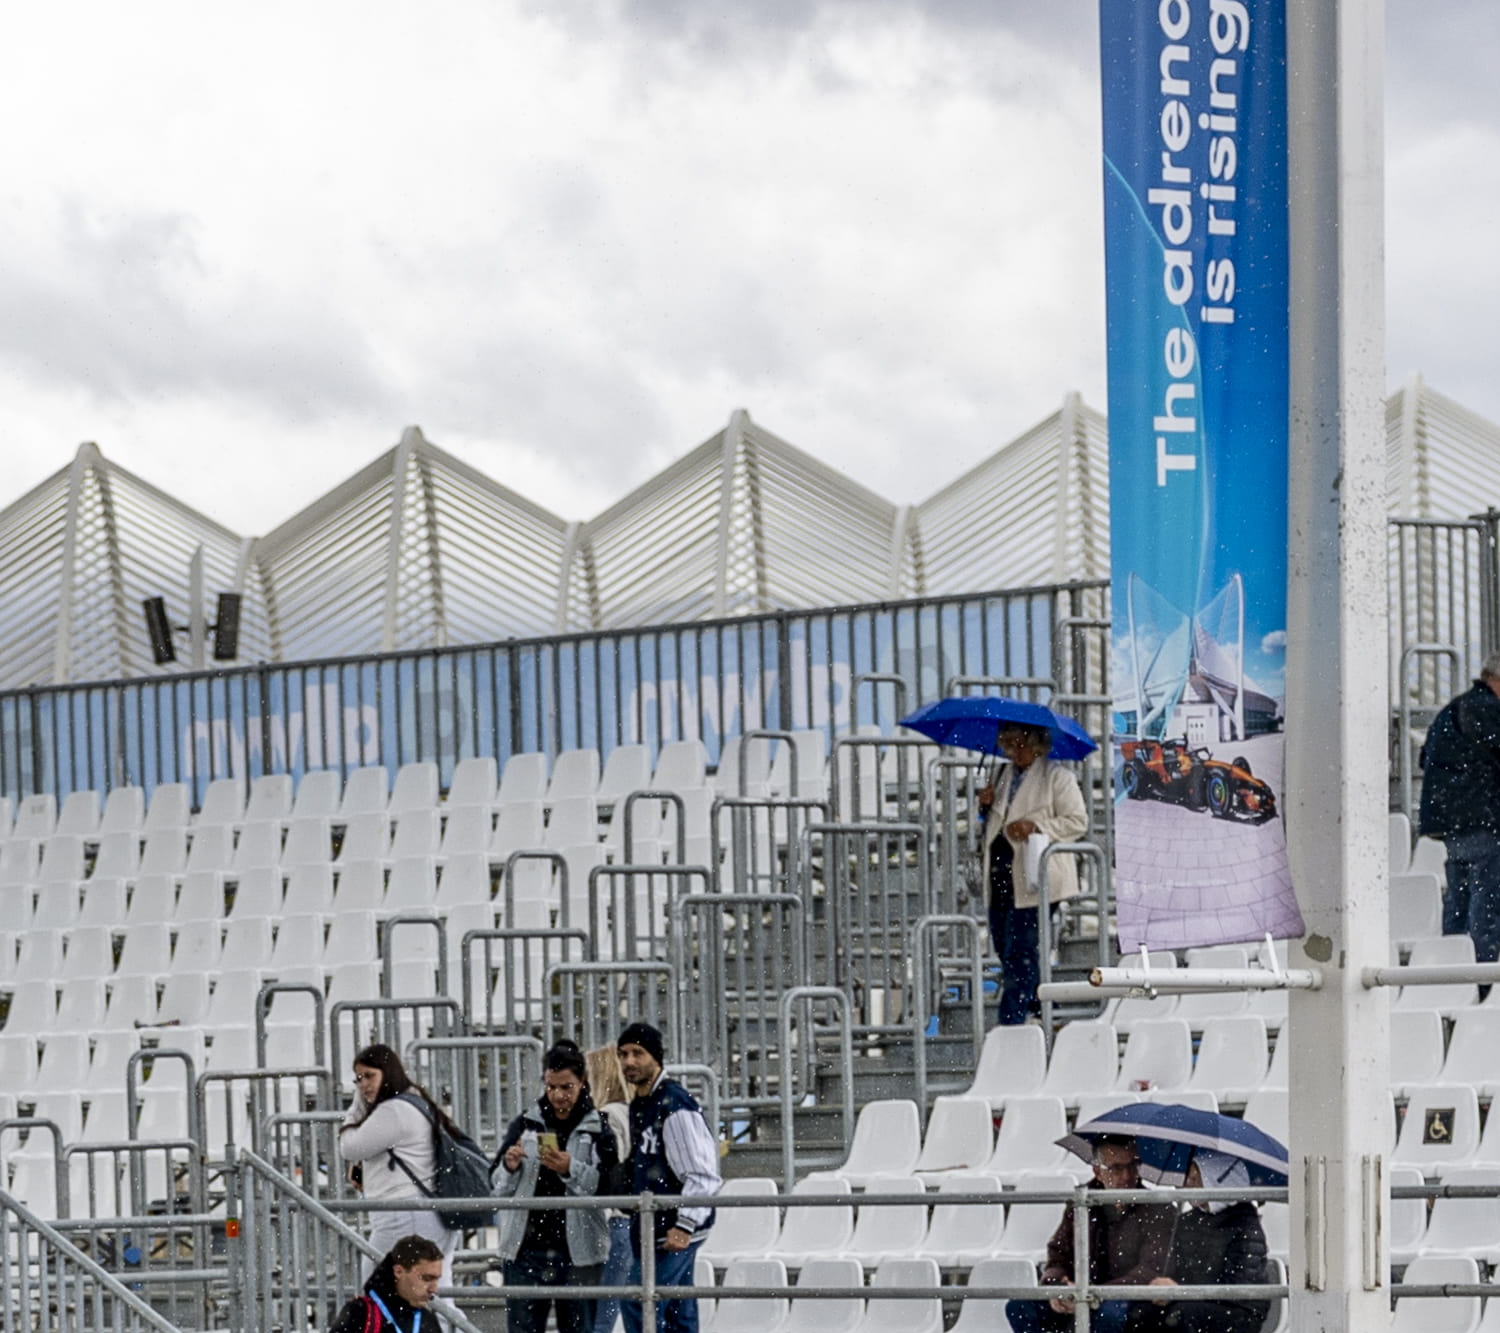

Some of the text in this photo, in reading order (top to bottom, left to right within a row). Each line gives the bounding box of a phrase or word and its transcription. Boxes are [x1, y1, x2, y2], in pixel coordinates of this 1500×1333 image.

[1198, 0, 1250, 325] is rising
[1153, 327, 1197, 487] The
